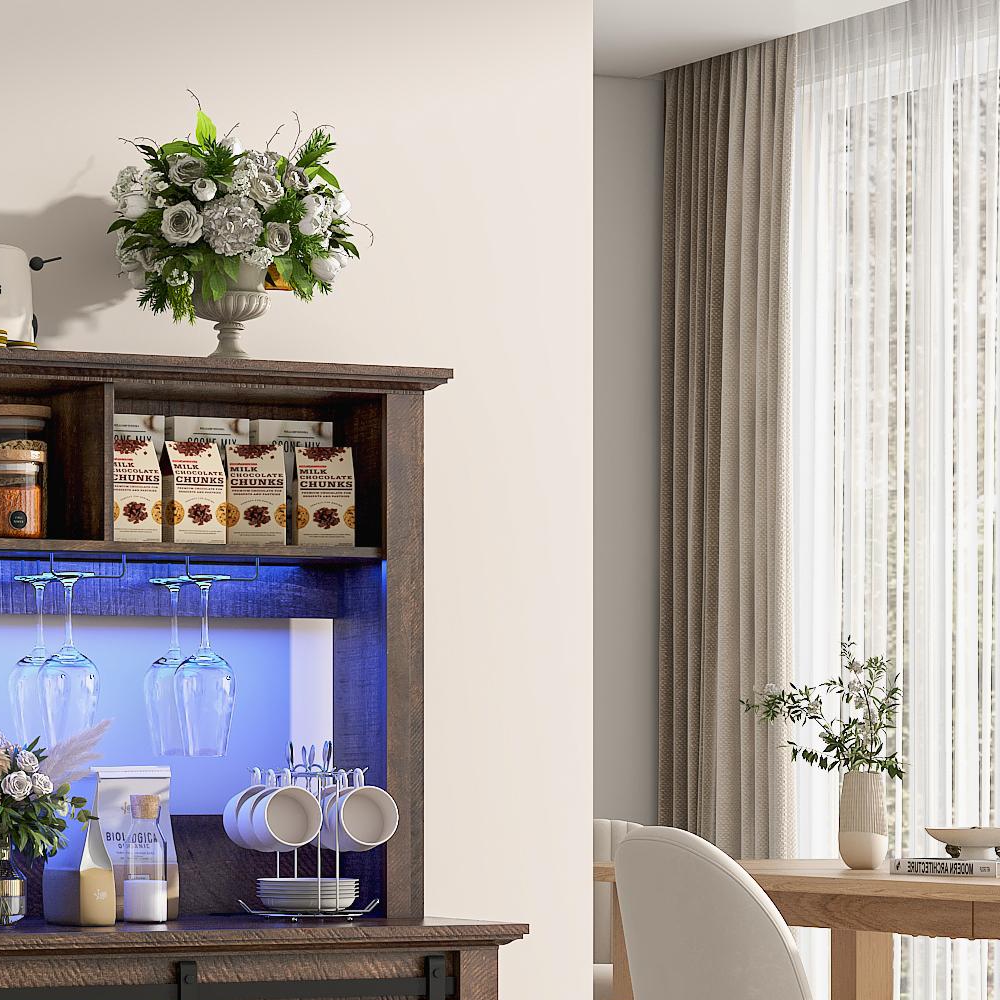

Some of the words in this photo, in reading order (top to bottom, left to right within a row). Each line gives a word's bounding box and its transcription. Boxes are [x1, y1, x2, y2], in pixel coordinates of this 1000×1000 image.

[113, 474, 160, 482] CHUNKS
[175, 475, 224, 484] CHUNKS
[230, 478, 284, 486] CHUNKS
[300, 480, 353, 488] CHUNKS
